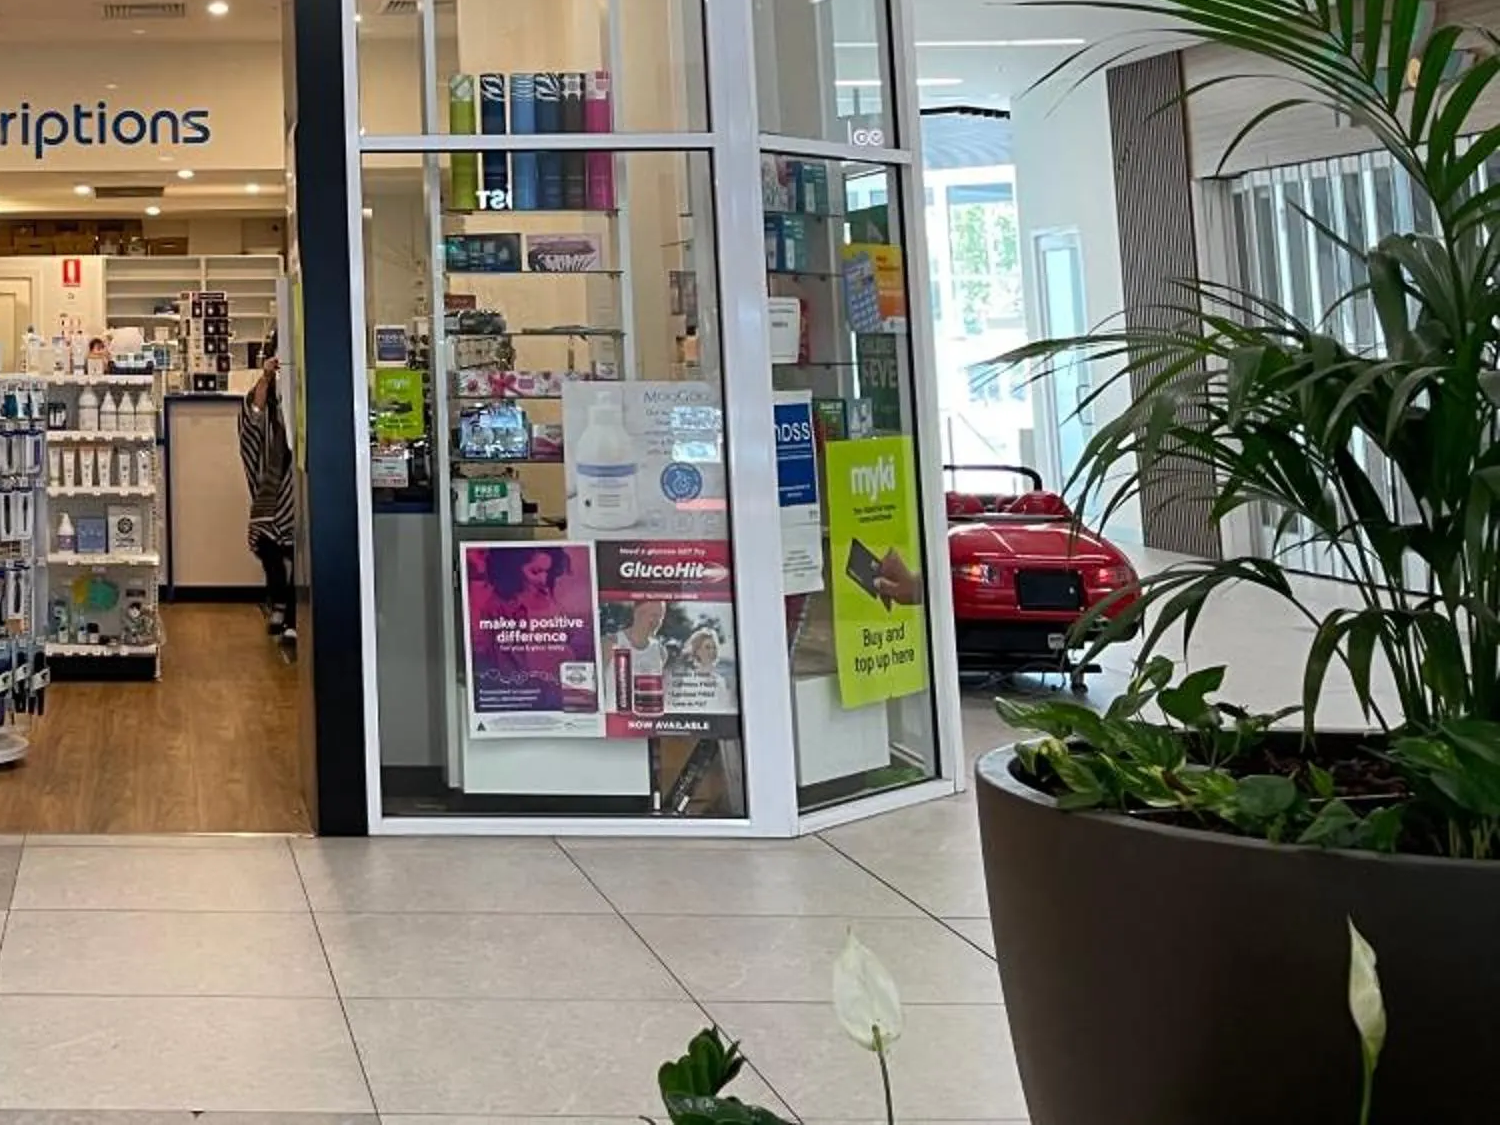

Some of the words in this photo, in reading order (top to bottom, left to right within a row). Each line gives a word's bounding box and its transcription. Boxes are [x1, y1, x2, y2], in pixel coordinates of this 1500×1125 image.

[851, 454, 895, 502] myki
[620, 561, 704, 578] GlucoHit
[480, 616, 517, 630] make
[520, 619, 527, 629] a
[530, 615, 584, 631] positive
[497, 631, 568, 643] difference
[863, 628, 883, 649] Buy
[886, 622, 905, 642] and
[855, 657, 874, 675] top
[876, 654, 890, 673] up
[891, 648, 915, 665] here
[628, 721, 653, 730] NOW
[655, 721, 709, 730] AVAILABLE
